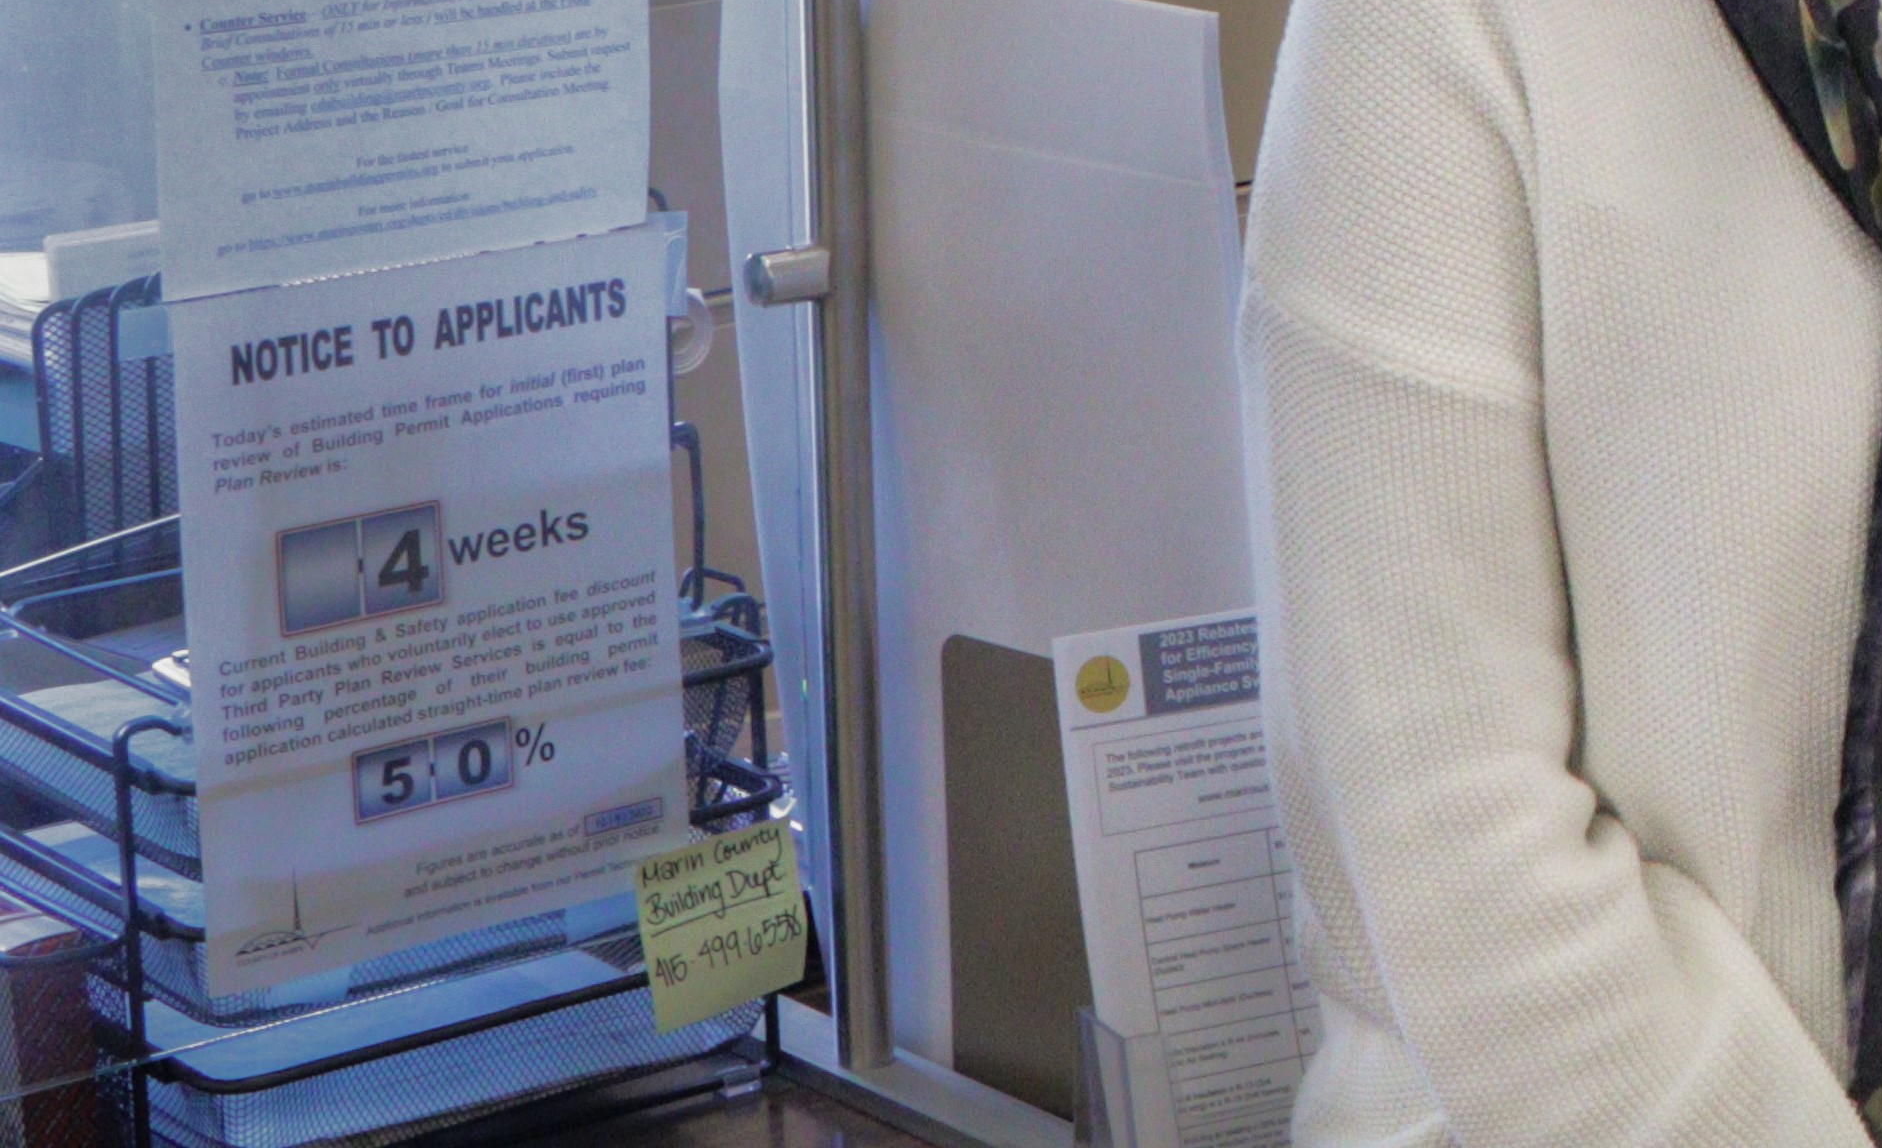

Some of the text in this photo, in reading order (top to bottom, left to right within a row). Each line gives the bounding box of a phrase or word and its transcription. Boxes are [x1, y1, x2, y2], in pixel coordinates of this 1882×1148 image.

[229, 278, 627, 385] NOTICE TO APPLICANTS
[212, 377, 646, 472] review of Building Permit Applications requiring
[289, 406, 373, 436] estimated
[381, 397, 417, 418] time
[424, 387, 472, 410] frame
[479, 382, 502, 399] for
[509, 372, 556, 395] initial
[560, 363, 604, 387] (first)
[610, 356, 645, 378] plan
[213, 455, 348, 494] Plan Review is:
[378, 509, 589, 594] 4 weeks
[218, 571, 655, 678] Current Building & Safety application fee discount
[220, 593, 656, 699] for applicants who voluntarily elect to use approved
[221, 611, 657, 720] Third Party Plan Review Services is equal to the
[221, 632, 658, 746] following percentage of their building permit
[224, 654, 651, 767] application calculated straight-time plan review fee:
[642, 827, 783, 888] Marin County
[646, 880, 725, 925] Building
